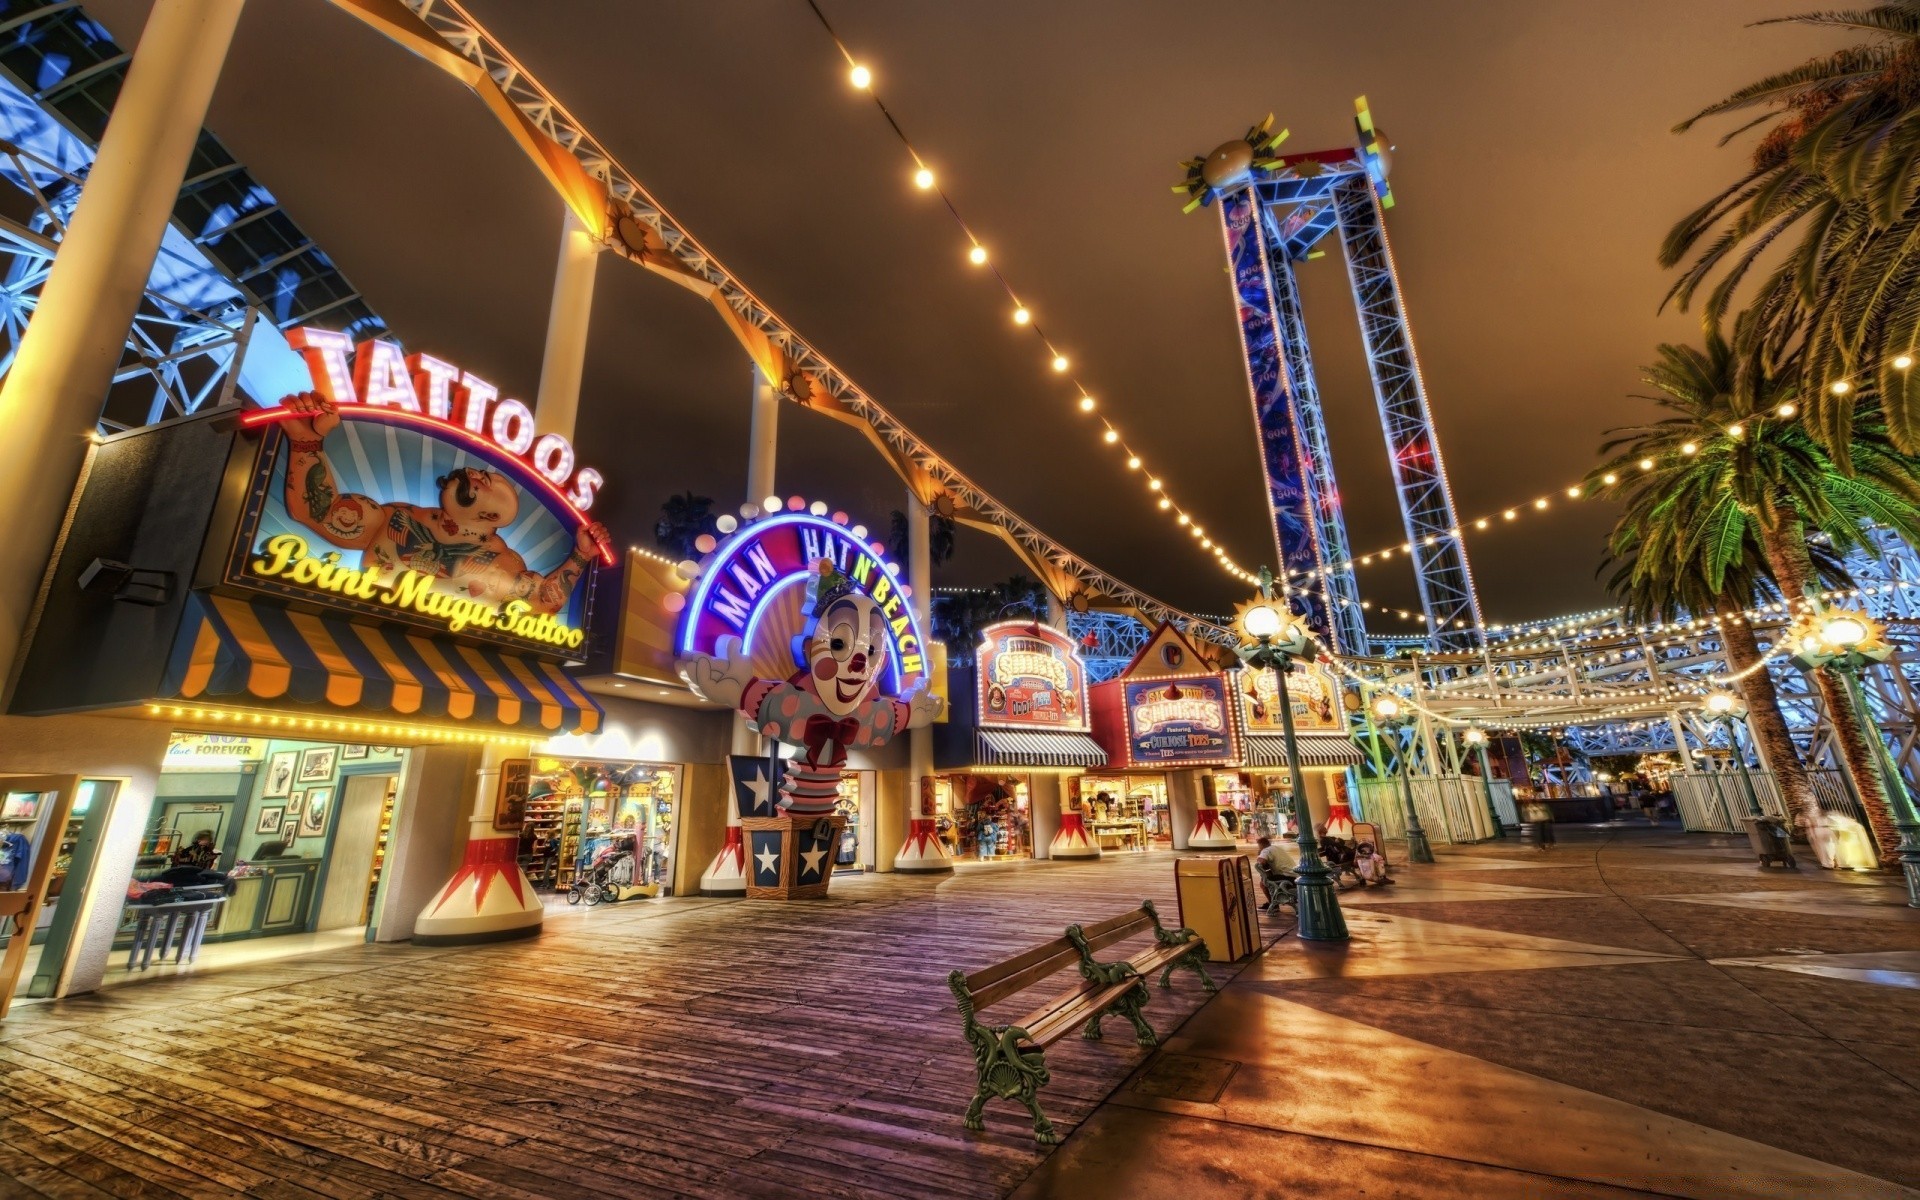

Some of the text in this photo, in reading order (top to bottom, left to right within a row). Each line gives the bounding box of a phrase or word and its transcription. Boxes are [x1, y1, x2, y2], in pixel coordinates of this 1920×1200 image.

[287, 326, 604, 511] TATTOOS
[1267, 426, 1288, 439] 600
[1277, 486, 1297, 499] 500
[1288, 549, 1310, 562] 400
[252, 533, 584, 649] Point Mugu Tattoo
[713, 542, 777, 630] MAN
[803, 528, 852, 572] HAT
[874, 574, 922, 674] BEACH
[1010, 639, 1052, 658] SIDESHOW
[1136, 700, 1221, 735] SHIRTS
[195, 745, 252, 755] FOREVER
